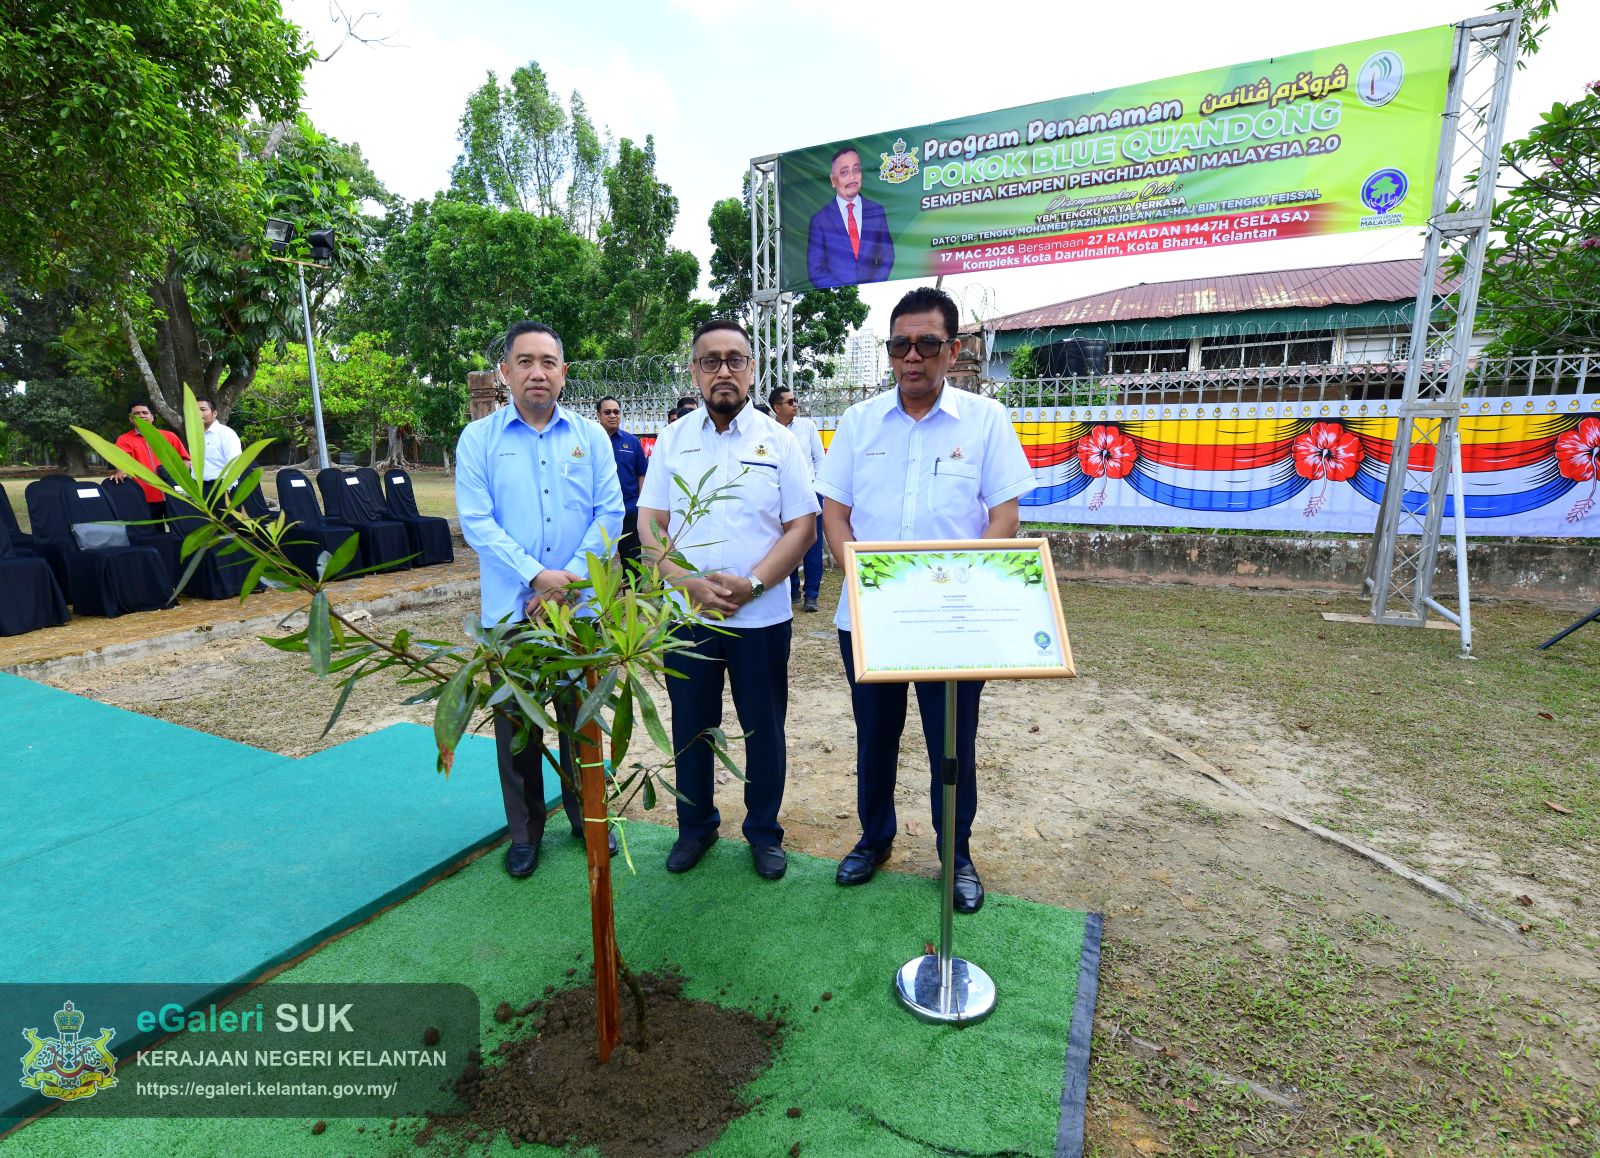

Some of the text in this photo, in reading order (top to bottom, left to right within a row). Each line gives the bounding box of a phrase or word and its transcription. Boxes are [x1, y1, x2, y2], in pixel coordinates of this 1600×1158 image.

[923, 100, 1343, 190] POKOK BLUE QUANDONG
[924, 100, 1182, 161] Program Penanaman
[921, 135, 1340, 209] SEMPENA KEMPEN PENGHIJAUAN MALAYSIA 2.0
[961, 233, 977, 243] DR.
[979, 228, 1016, 240] TENGKU
[1018, 221, 1068, 235] MOHAMED
[1070, 210, 1152, 228] FAZIHARUDEAN
[1155, 205, 1196, 217] AL-HAJ
[1198, 202, 1218, 213] BIN
[1220, 196, 1268, 209] TENGKU
[1271, 189, 1322, 203] FEISSAL
[1036, 196, 1186, 223] YBM TENGKU KAYA PERKASA
[1046, 187, 1139, 211] Disempurnakan
[1361, 218, 1401, 227] MALAYSIA
[941, 211, 1311, 263] 17 MAC 2026 Bersamaan 27 RAMADAN 1447H (SELASA)
[962, 228, 1278, 271] Kompleks Kota Darulnaim, Kota Bharu, Kelantan
